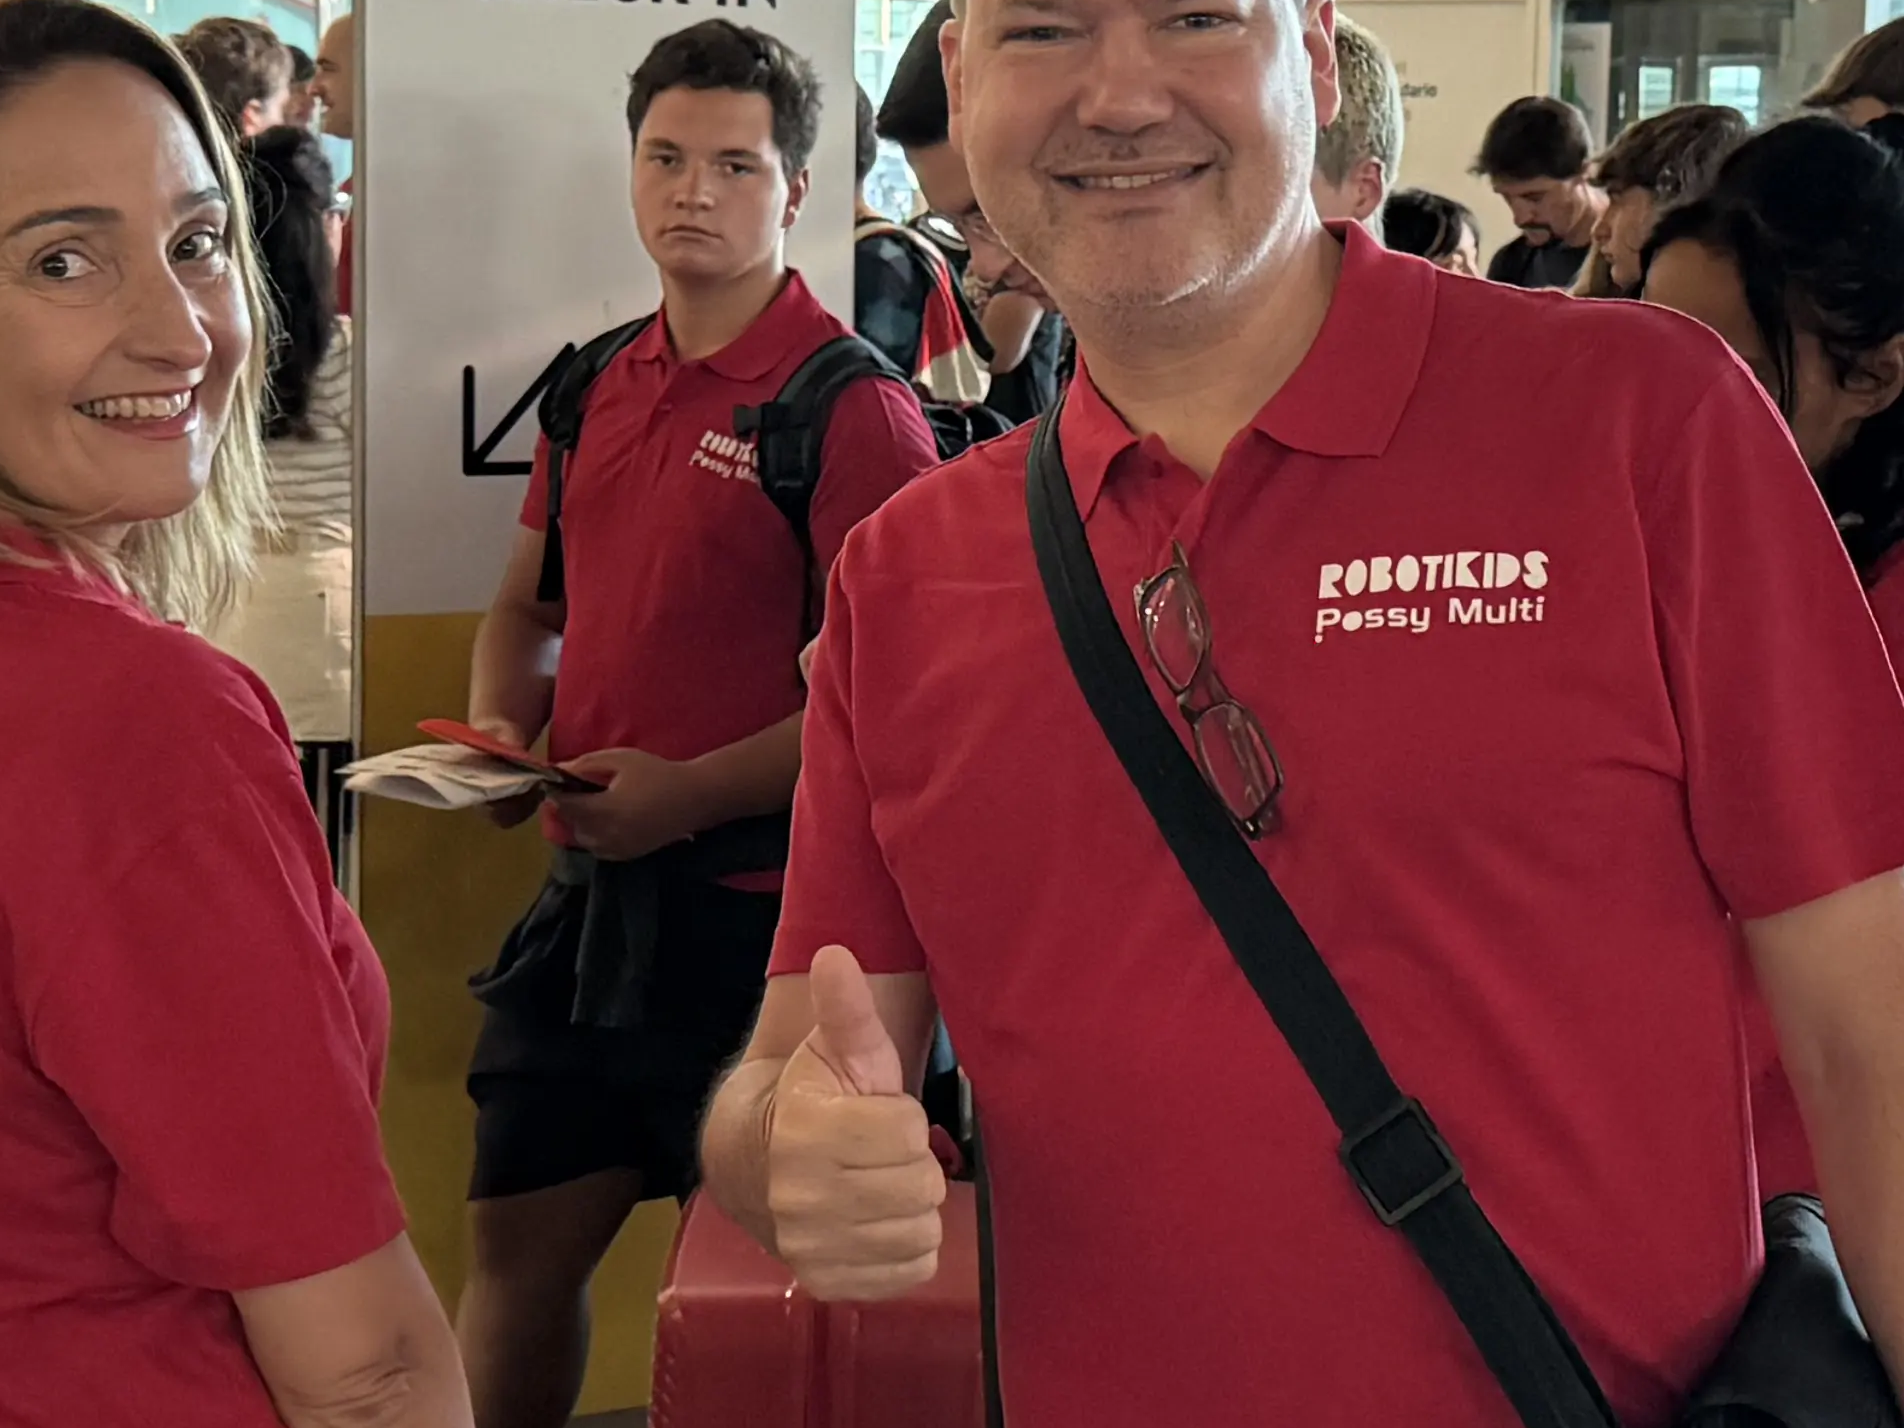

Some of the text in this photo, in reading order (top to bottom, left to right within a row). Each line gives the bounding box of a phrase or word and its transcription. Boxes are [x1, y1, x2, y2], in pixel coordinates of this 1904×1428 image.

[1318, 550, 1550, 599] ROBOTIKIDS
[1314, 596, 1546, 644] Possy Multi
